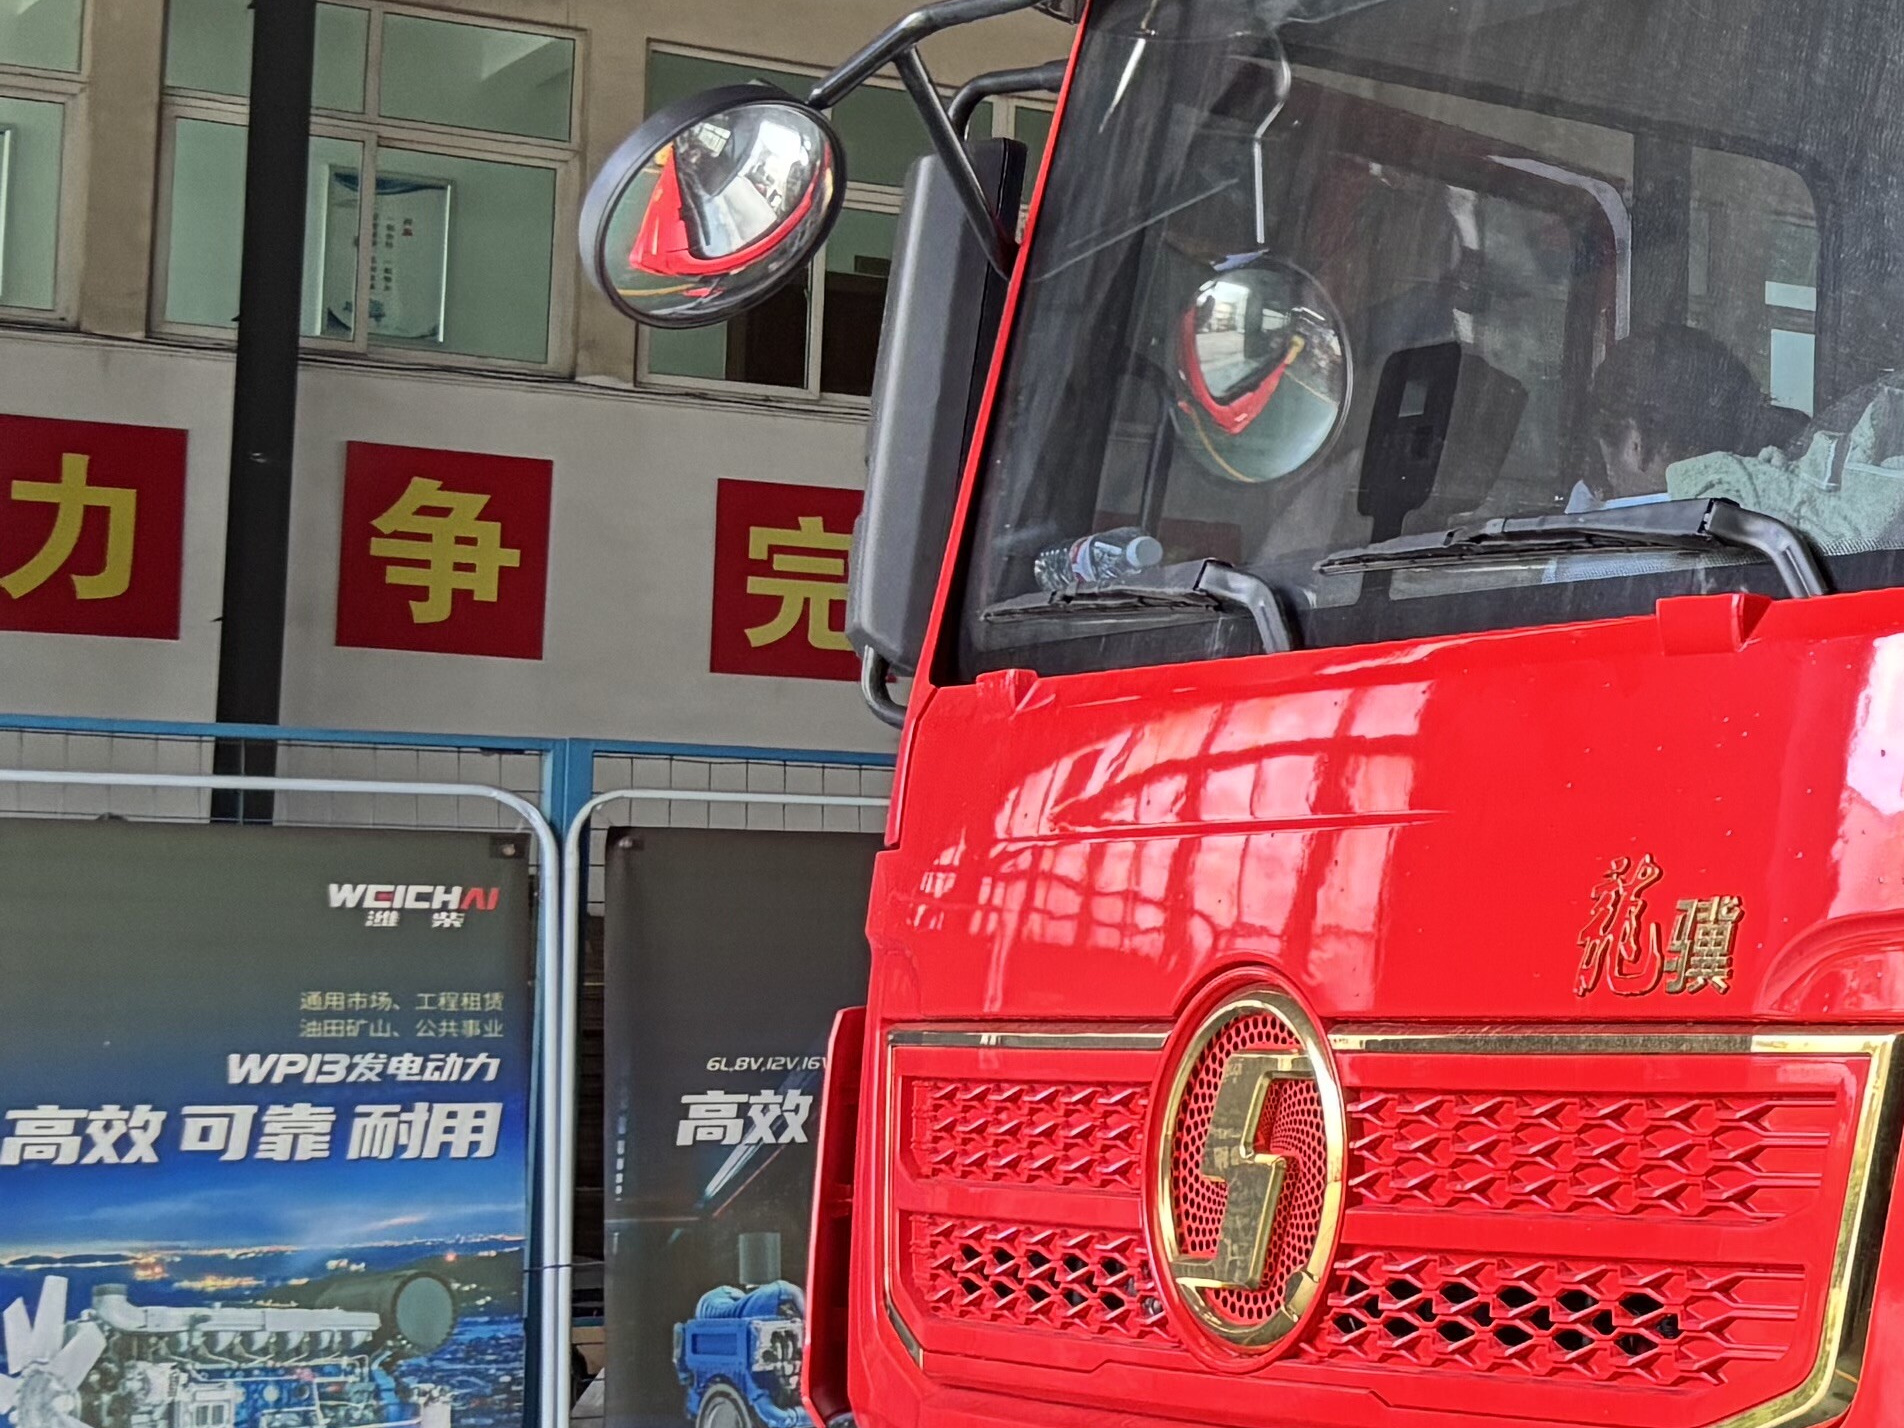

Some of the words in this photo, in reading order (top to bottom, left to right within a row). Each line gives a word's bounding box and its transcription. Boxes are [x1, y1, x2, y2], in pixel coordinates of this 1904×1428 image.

[0, 453, 138, 601] 力
[369, 475, 522, 625] 争
[328, 883, 500, 911] WEICHAI
[365, 910, 465, 928] 潍柴
[227, 1051, 500, 1084] WP13发电动力
[0, 1104, 168, 1167] 高效
[179, 1101, 338, 1162] 可靠
[346, 1100, 503, 1161] 耐用
[676, 1089, 813, 1146] 高效
